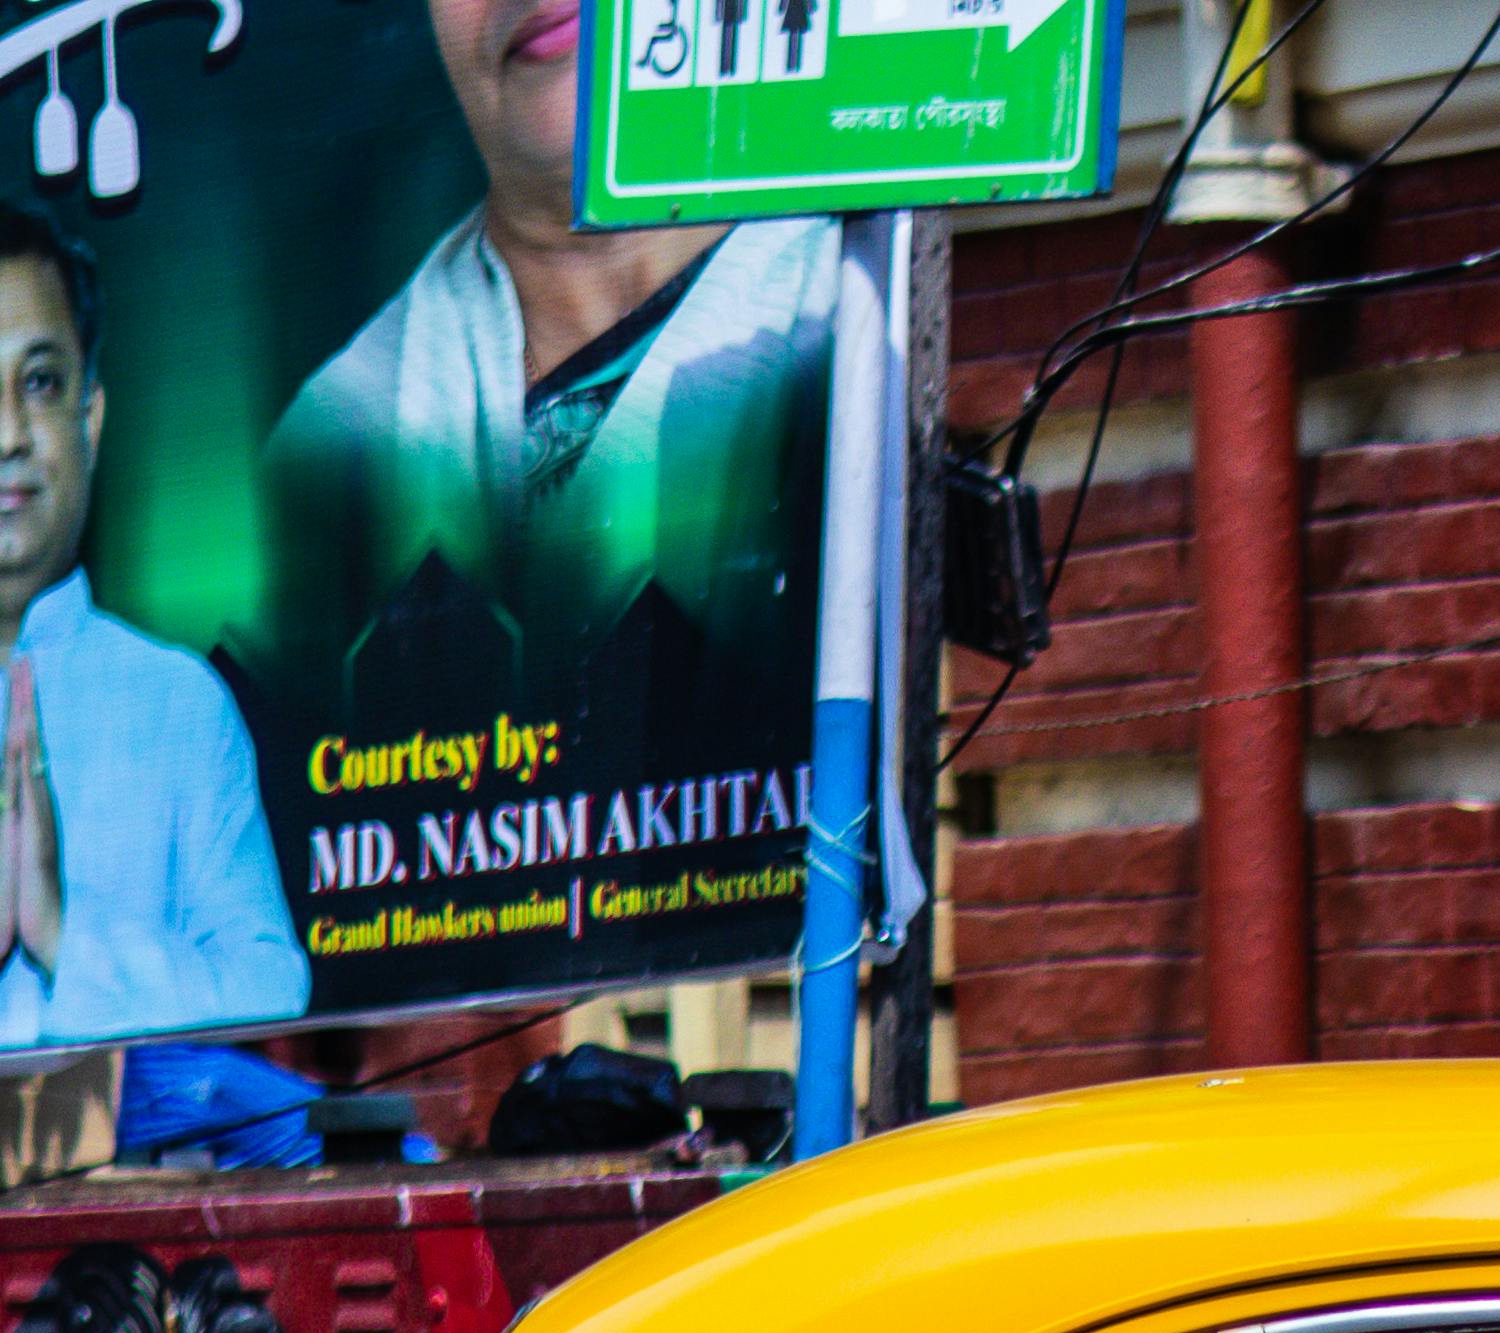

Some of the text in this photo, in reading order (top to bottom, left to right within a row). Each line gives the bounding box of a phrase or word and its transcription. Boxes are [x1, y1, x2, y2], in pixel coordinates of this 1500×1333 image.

[308, 711, 560, 796] Courtesy by:
[308, 819, 409, 893] MD.
[416, 792, 592, 880] NASIM
[308, 908, 388, 956] Grand
[390, 902, 496, 948] Hawkers
[498, 888, 568, 934] union
[590, 870, 691, 922] General
